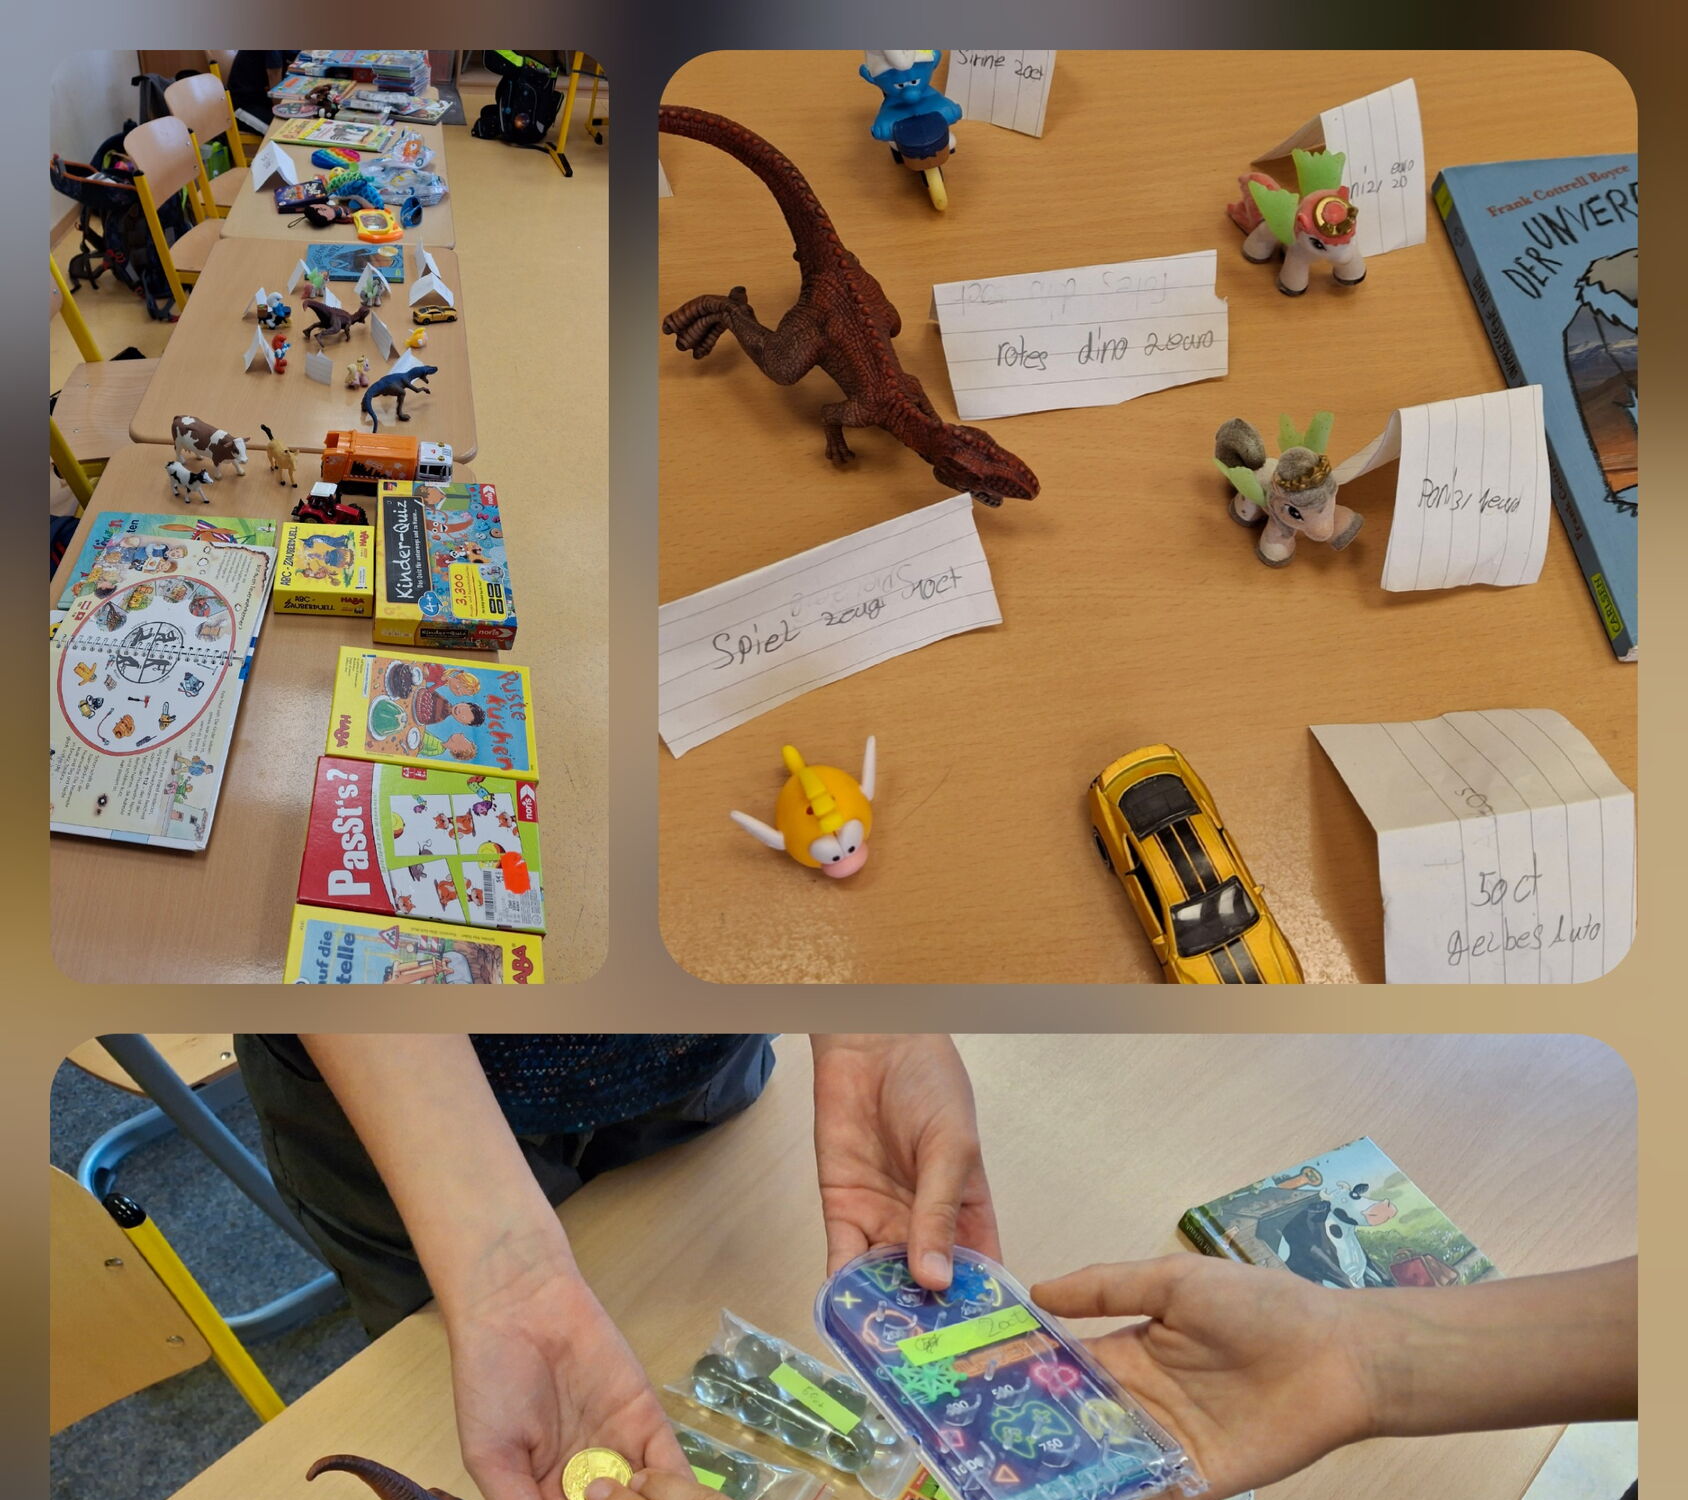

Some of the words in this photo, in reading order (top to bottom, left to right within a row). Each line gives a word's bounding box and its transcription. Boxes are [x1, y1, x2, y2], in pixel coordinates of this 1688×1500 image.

[1486, 195, 1533, 217] Frank
[1533, 175, 1590, 201] Cottrell
[1587, 164, 1631, 184] Boyce
[1501, 247, 1563, 299] DER
[997, 335, 1049, 371] rotes
[1078, 326, 1129, 365] dino
[392, 500, 414, 599] Kinder-Quiz
[454, 574, 467, 606] 3.300
[1594, 576, 1624, 636] CARLSEN
[333, 714, 352, 749] HABA
[525, 797, 534, 821] noris
[317, 929, 334, 956] die
[1038, 1438, 1064, 1452] 750
